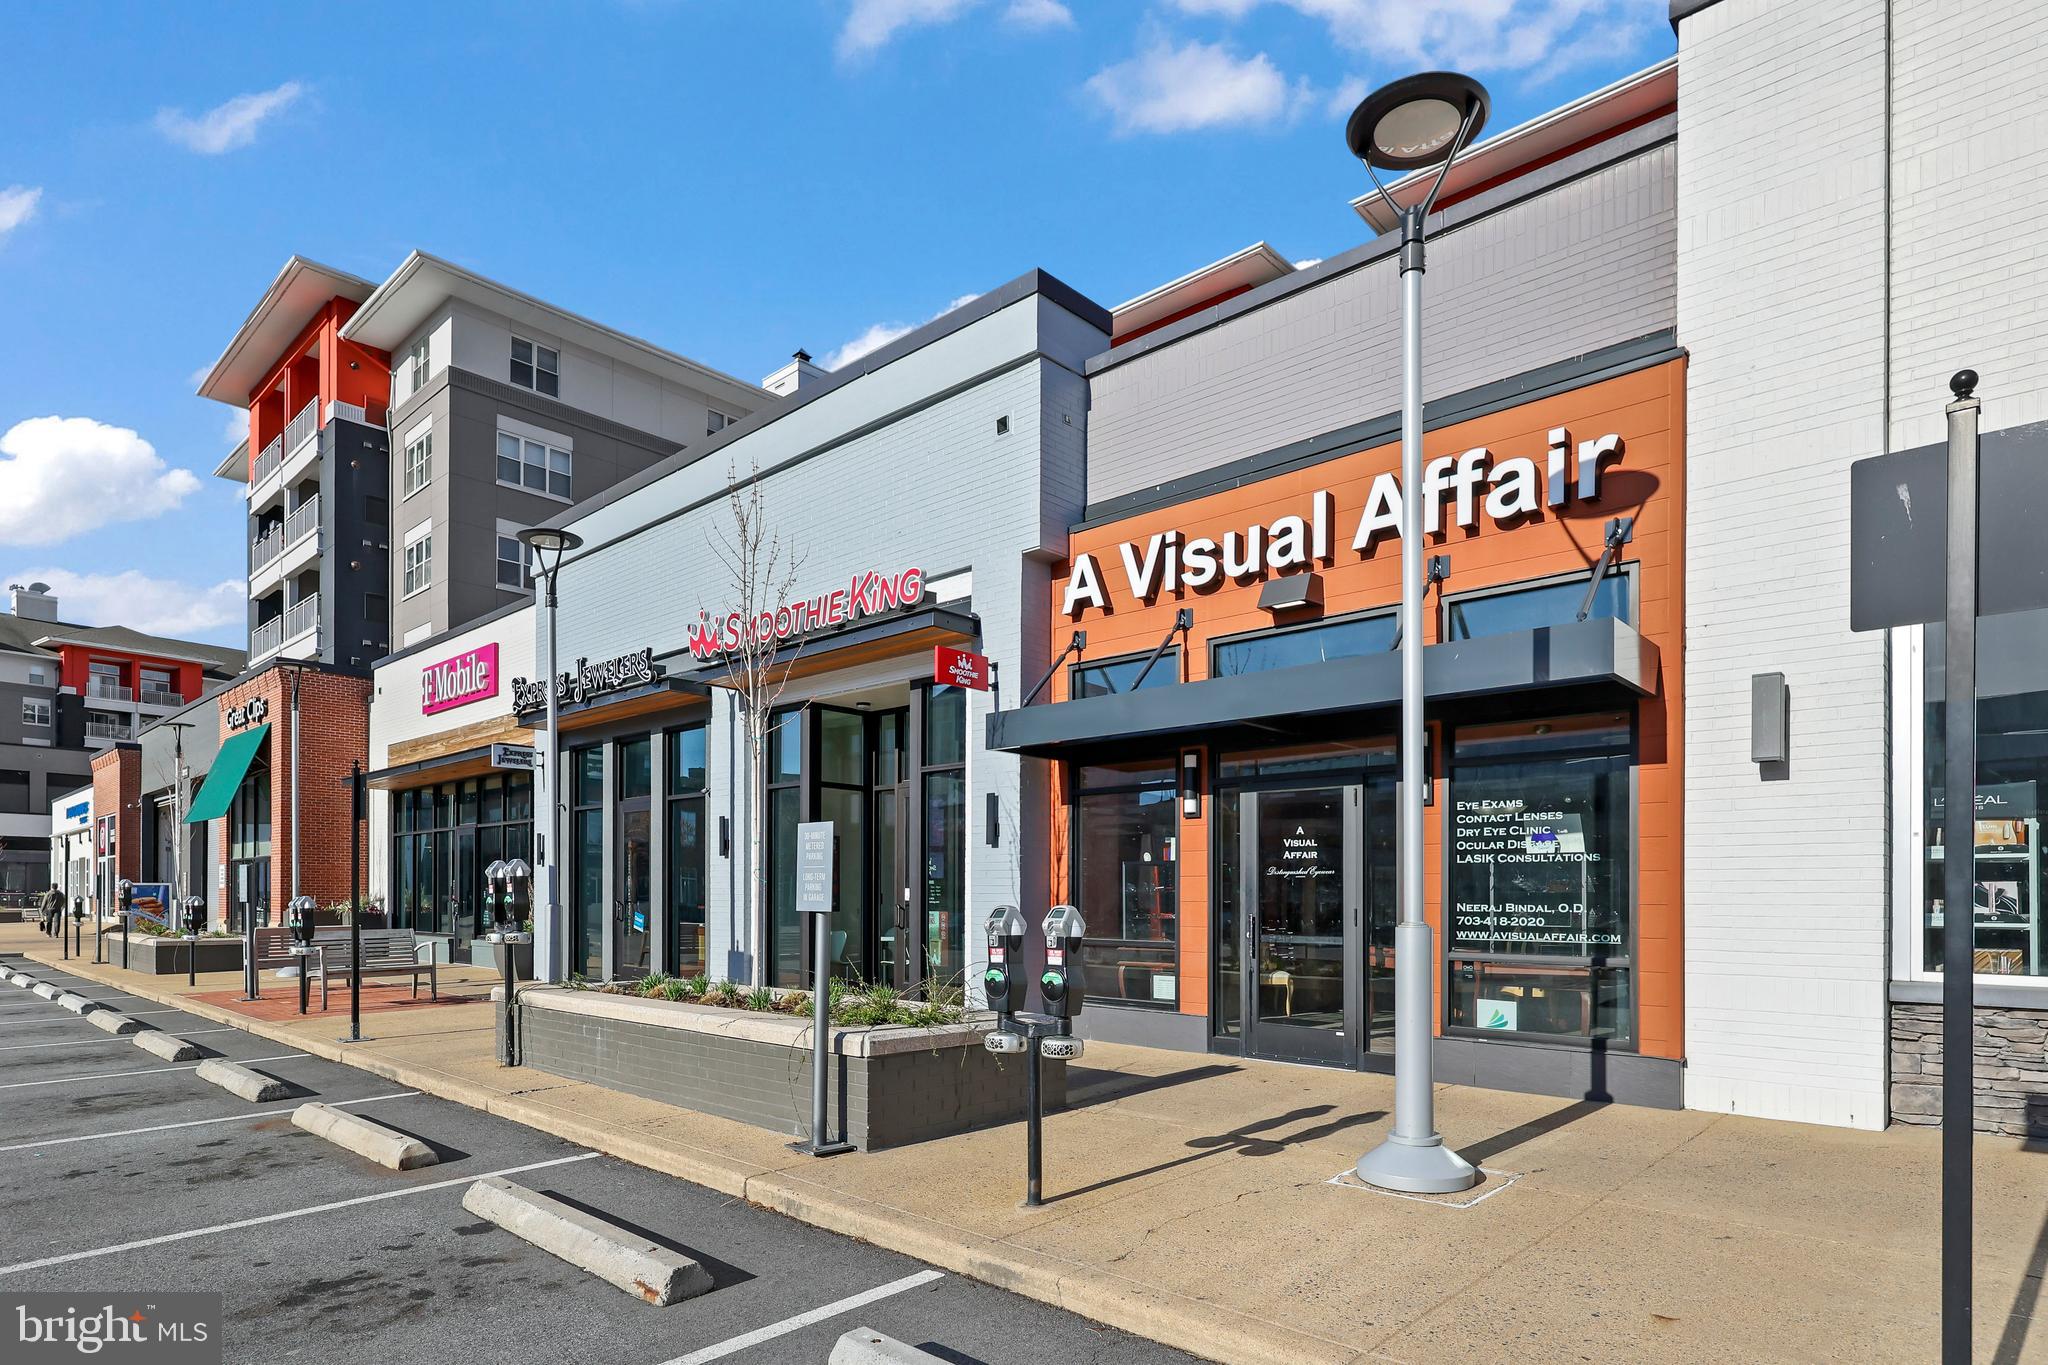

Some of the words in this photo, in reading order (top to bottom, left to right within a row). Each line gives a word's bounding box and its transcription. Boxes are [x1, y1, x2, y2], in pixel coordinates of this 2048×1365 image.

[1062, 553, 1106, 616] A
[1118, 489, 1330, 601] Visual
[1351, 426, 1622, 552] Affair
[725, 588, 847, 652] SMOOTHIE
[573, 648, 653, 703] JEWELERS
[949, 665, 979, 679] SMOOTHIE
[1482, 799, 1524, 810] EXAMS
[1456, 814, 1513, 824] CONTACT
[1514, 811, 1564, 822] LENSES
[1295, 826, 1305, 835] A
[1456, 828, 1481, 838] DRY
[1483, 827, 1507, 837] EYE
[1509, 826, 1551, 836] CLINIC
[1283, 839, 1318, 848] VISUAL
[1456, 840, 1505, 851] OCULAR
[1507, 839, 1560, 850] DISEASE
[1282, 850, 1318, 860] AFFAIR
[1456, 853, 1495, 864] LASIK
[1497, 853, 1601, 863] CONSULTATIONS
[1456, 902, 1503, 913] NEERAJ
[1505, 903, 1555, 914] BINDAL,
[1558, 903, 1588, 913] O.D.
[1456, 916, 1545, 927] 703-418-2020
[1456, 930, 1622, 944] WWW.AVISUALAFFAIR.COM
